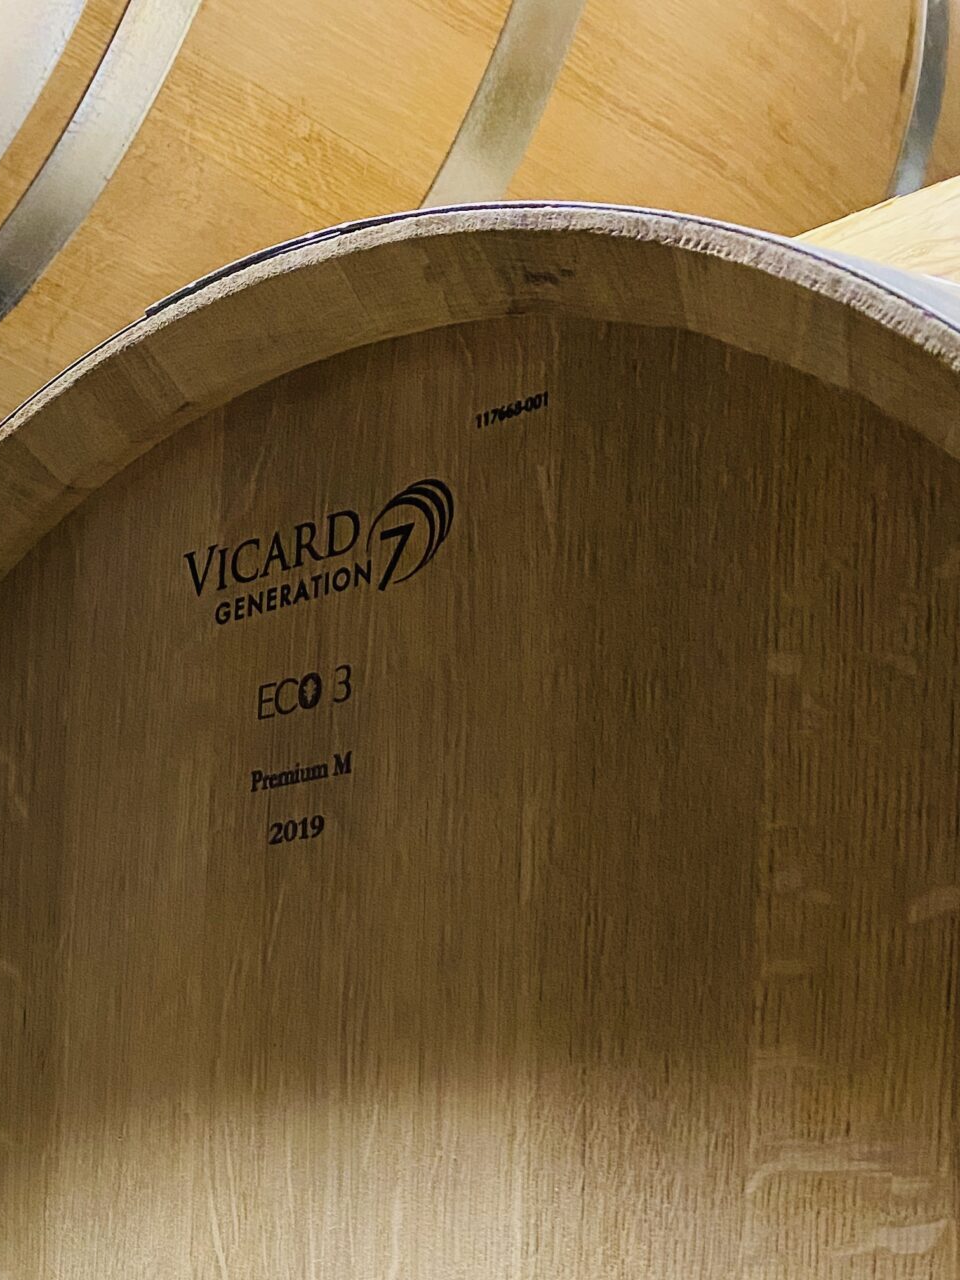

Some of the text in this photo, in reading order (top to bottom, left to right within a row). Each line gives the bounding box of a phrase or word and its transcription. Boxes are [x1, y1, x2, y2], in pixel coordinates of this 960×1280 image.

[184, 510, 360, 596] VICARD
[215, 559, 372, 625] GENERATION
[258, 664, 352, 720] ECO 3
[251, 751, 352, 792] Premium M
[269, 815, 325, 845] 2019
